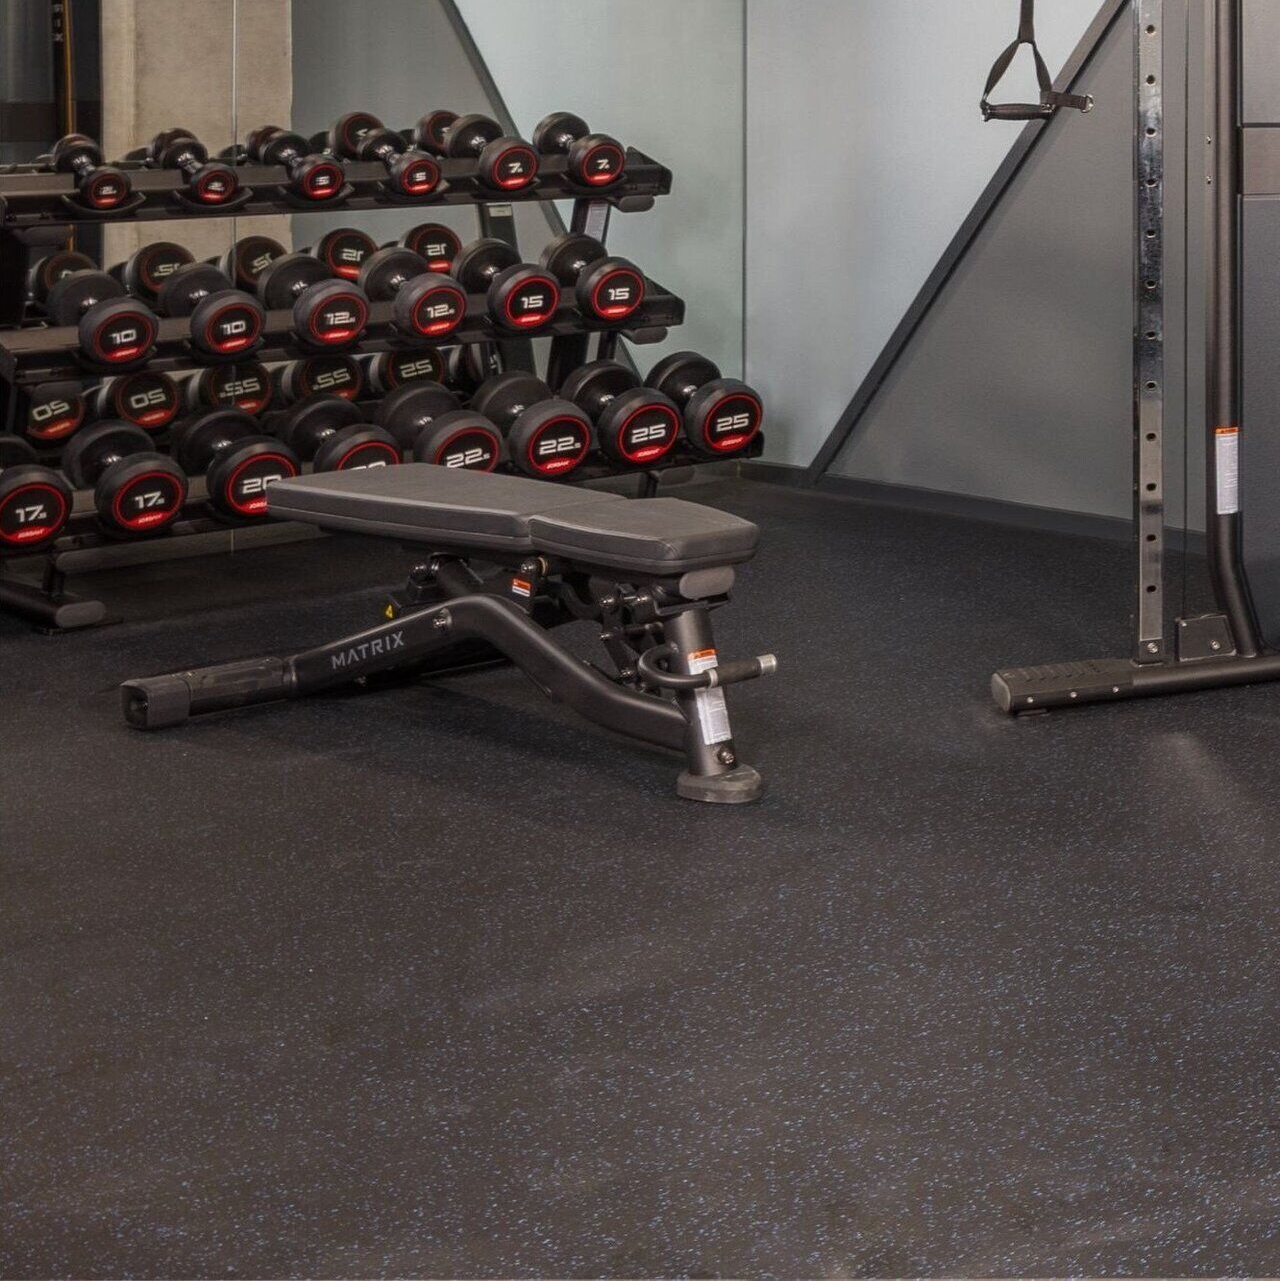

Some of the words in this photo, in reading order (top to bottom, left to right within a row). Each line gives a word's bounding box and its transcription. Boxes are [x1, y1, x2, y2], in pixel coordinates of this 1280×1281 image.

[521, 295, 544, 309] 15
[608, 288, 630, 301] 15
[110, 329, 137, 344] 10
[220, 321, 246, 335] 10
[716, 413, 749, 432] 25
[631, 423, 666, 444] 25
[539, 436, 581, 456] 22.5
[135, 490, 165, 509] 17.5
[15, 504, 47, 522] 17.5
[332, 631, 404, 670] MATRIX
